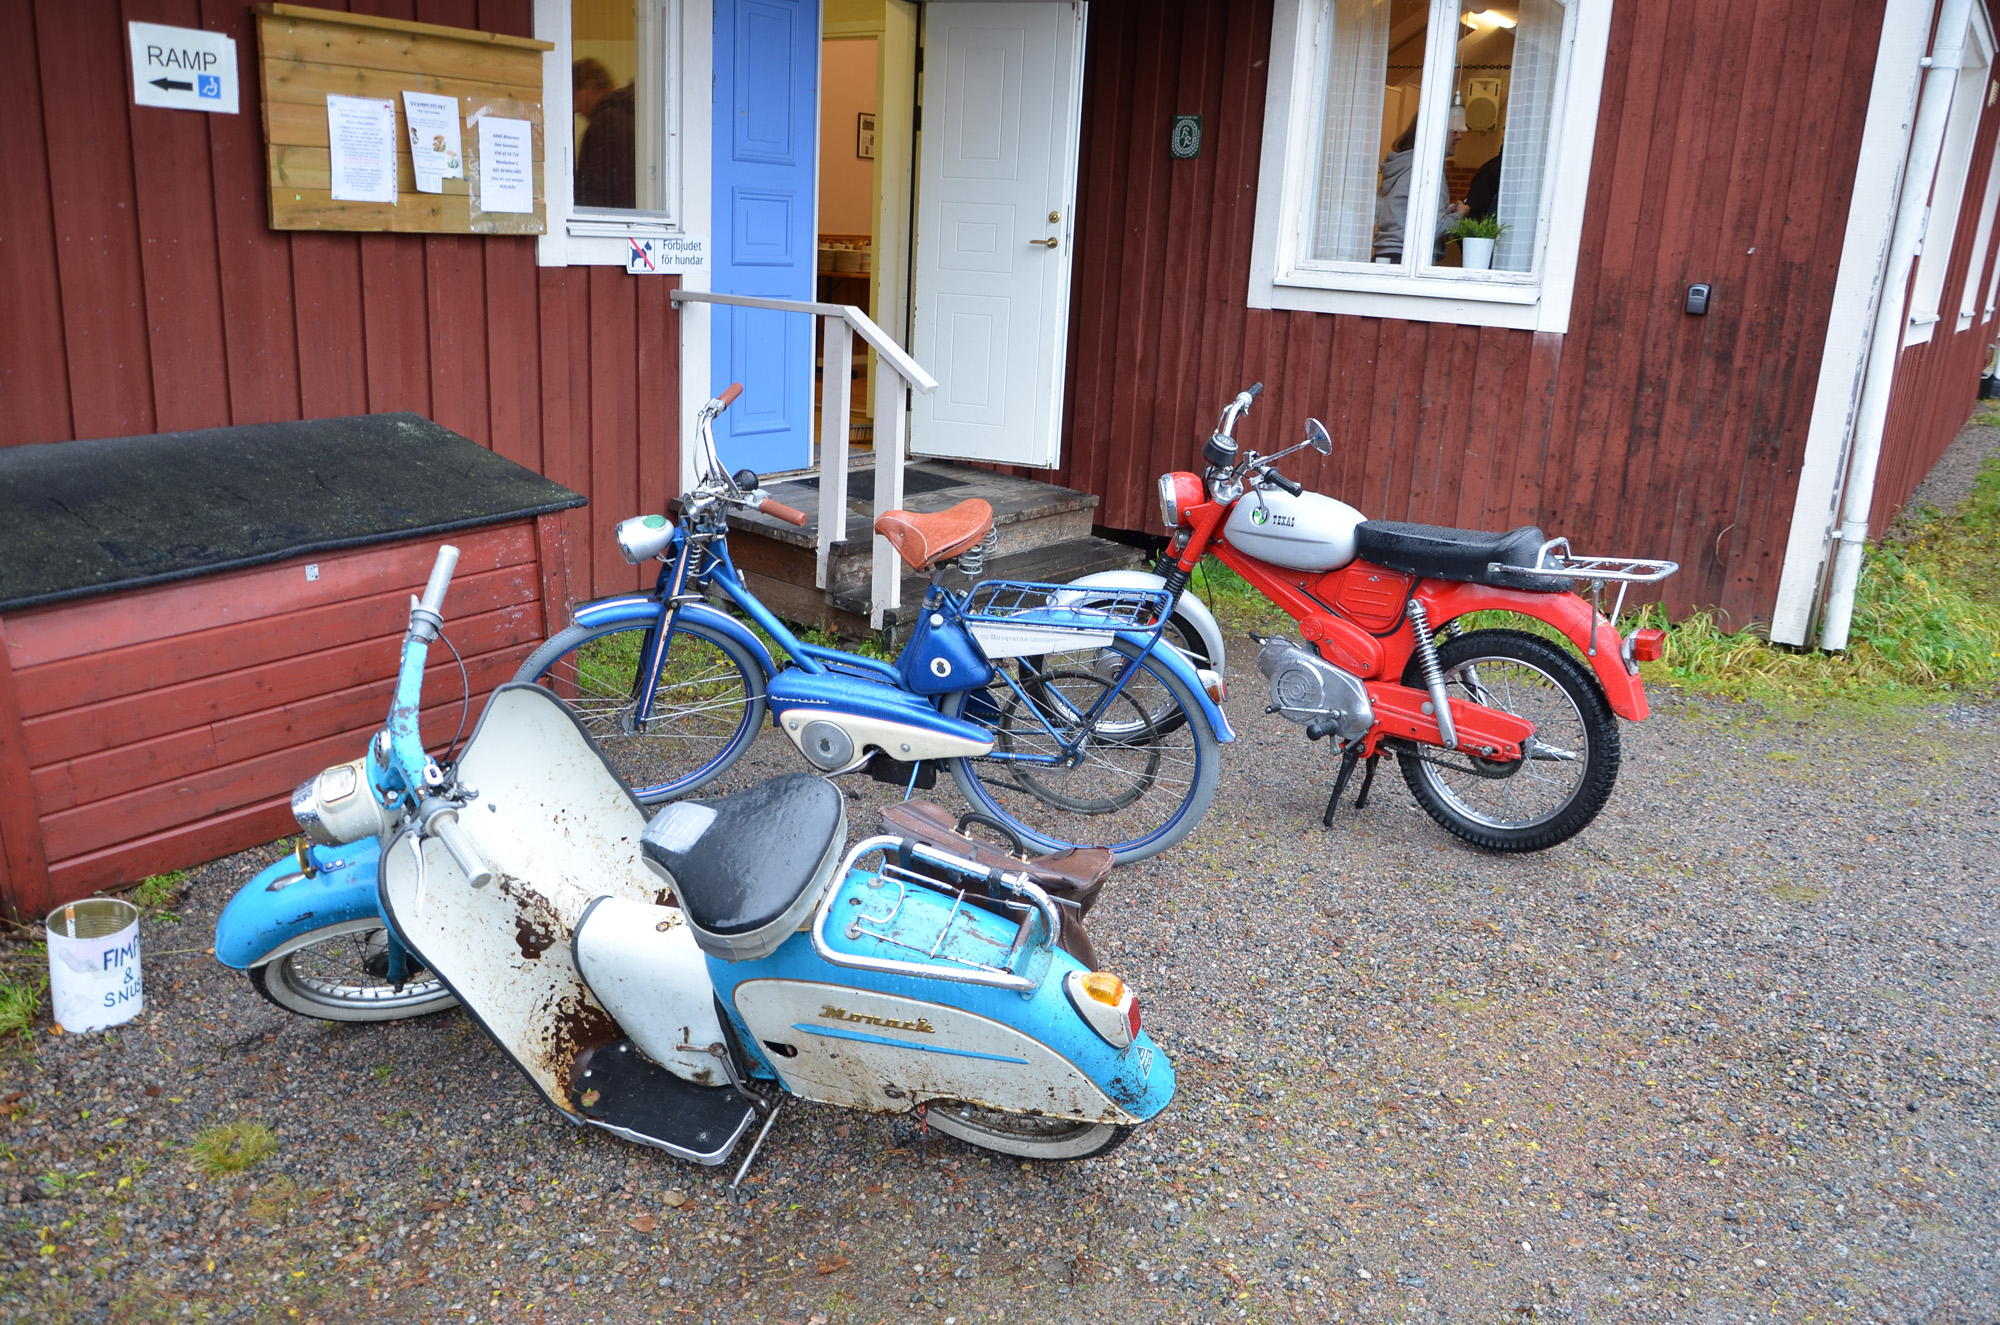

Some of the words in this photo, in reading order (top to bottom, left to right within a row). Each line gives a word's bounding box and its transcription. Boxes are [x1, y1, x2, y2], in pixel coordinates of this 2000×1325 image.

[147, 45, 217, 71] RAMP
[663, 239, 702, 252] Förbjudet
[661, 254, 673, 265] för
[675, 254, 703, 265] hundar
[1273, 514, 1295, 527] TEXAS
[990, 633, 1029, 642] Husqvarna
[123, 966, 134, 985] &
[818, 1004, 936, 1034] Monark
